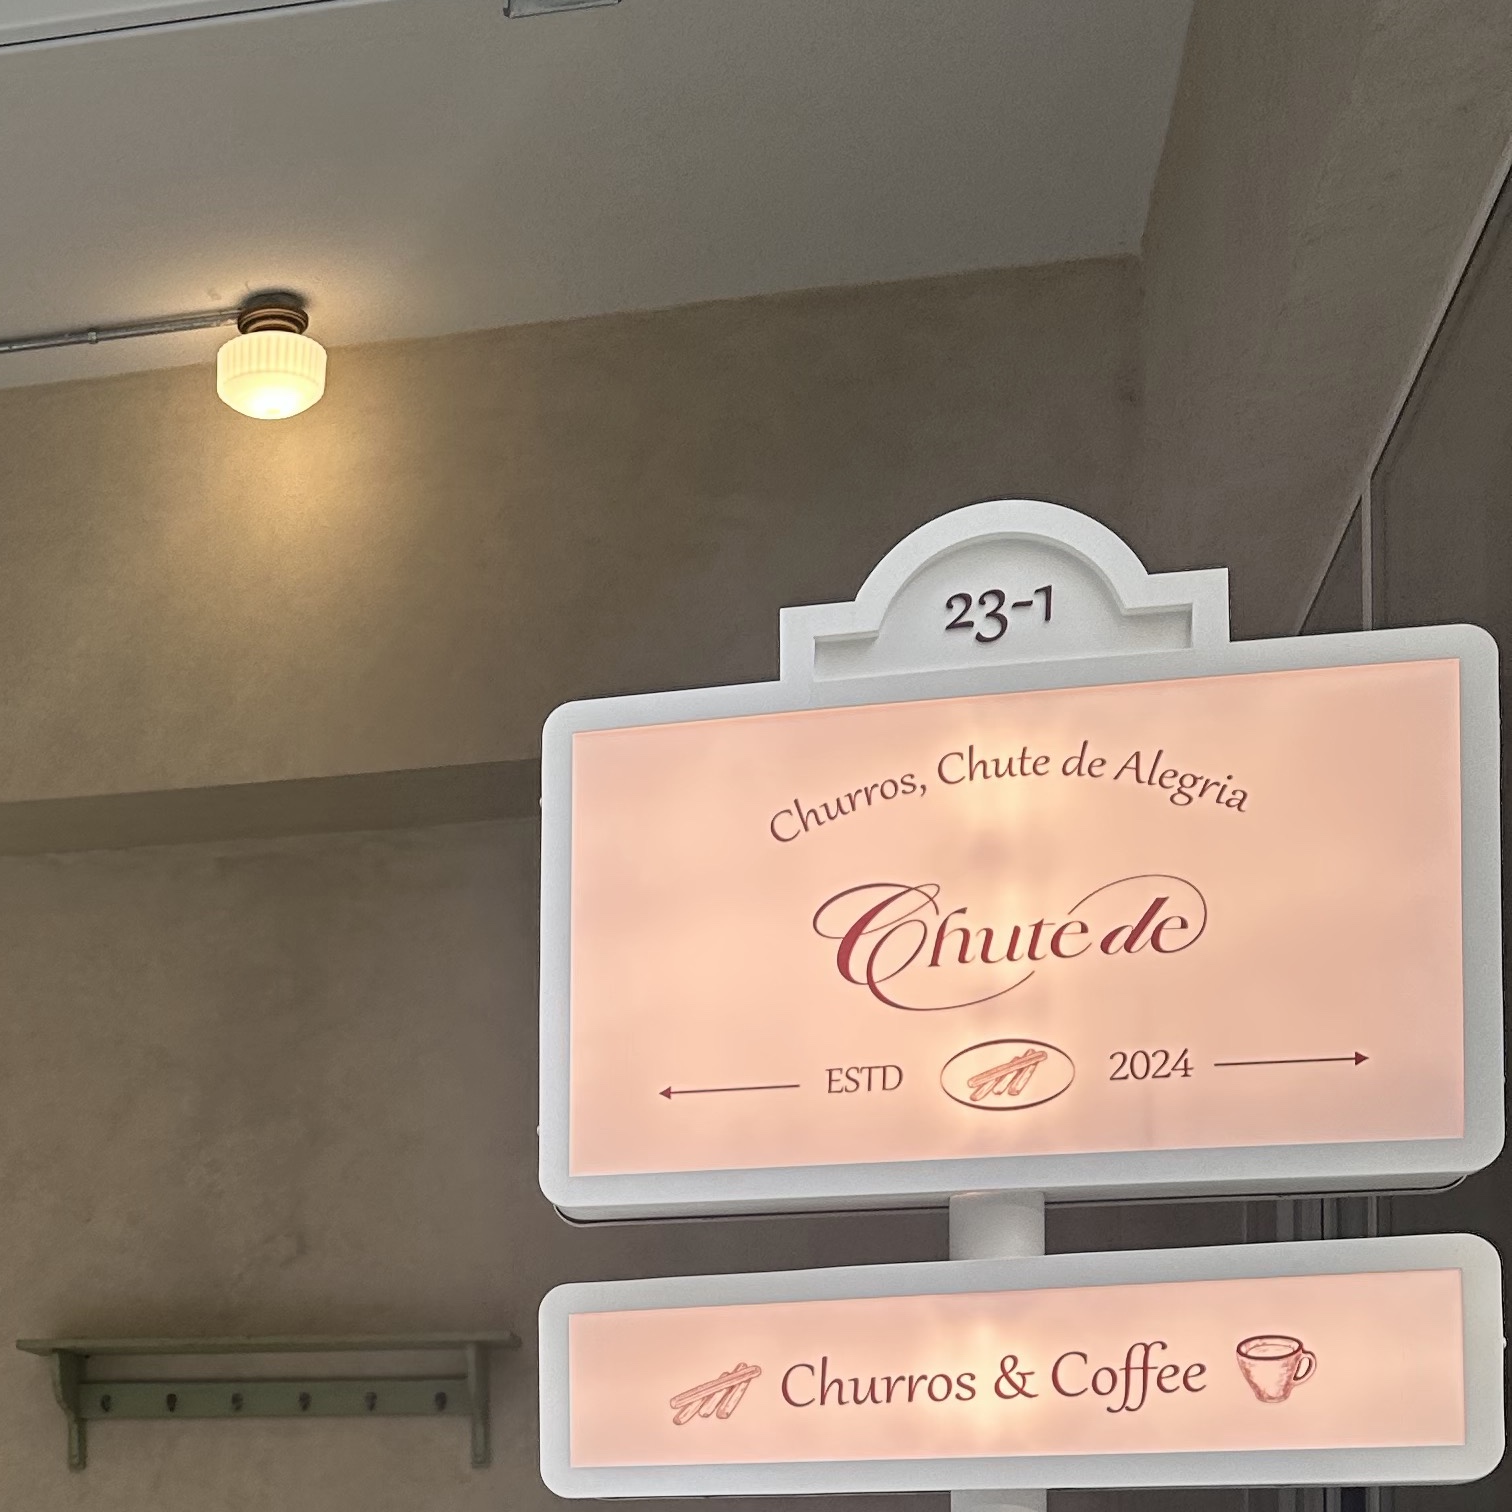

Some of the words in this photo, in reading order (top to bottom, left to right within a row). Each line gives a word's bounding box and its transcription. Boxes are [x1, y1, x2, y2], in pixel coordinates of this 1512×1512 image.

[945, 584, 1053, 642] 23-1
[769, 772, 929, 843] Churros,
[936, 743, 1051, 786] Chute
[1061, 739, 1107, 779] de
[1113, 748, 1249, 813] Alegria
[813, 882, 1092, 1012] Chute
[1086, 875, 1207, 956] de
[825, 1064, 904, 1095] ESTD
[1108, 1047, 1195, 1082] 2024
[781, 1356, 977, 1407] Churros
[993, 1354, 1040, 1400] &
[1051, 1341, 1208, 1413] Coffee
